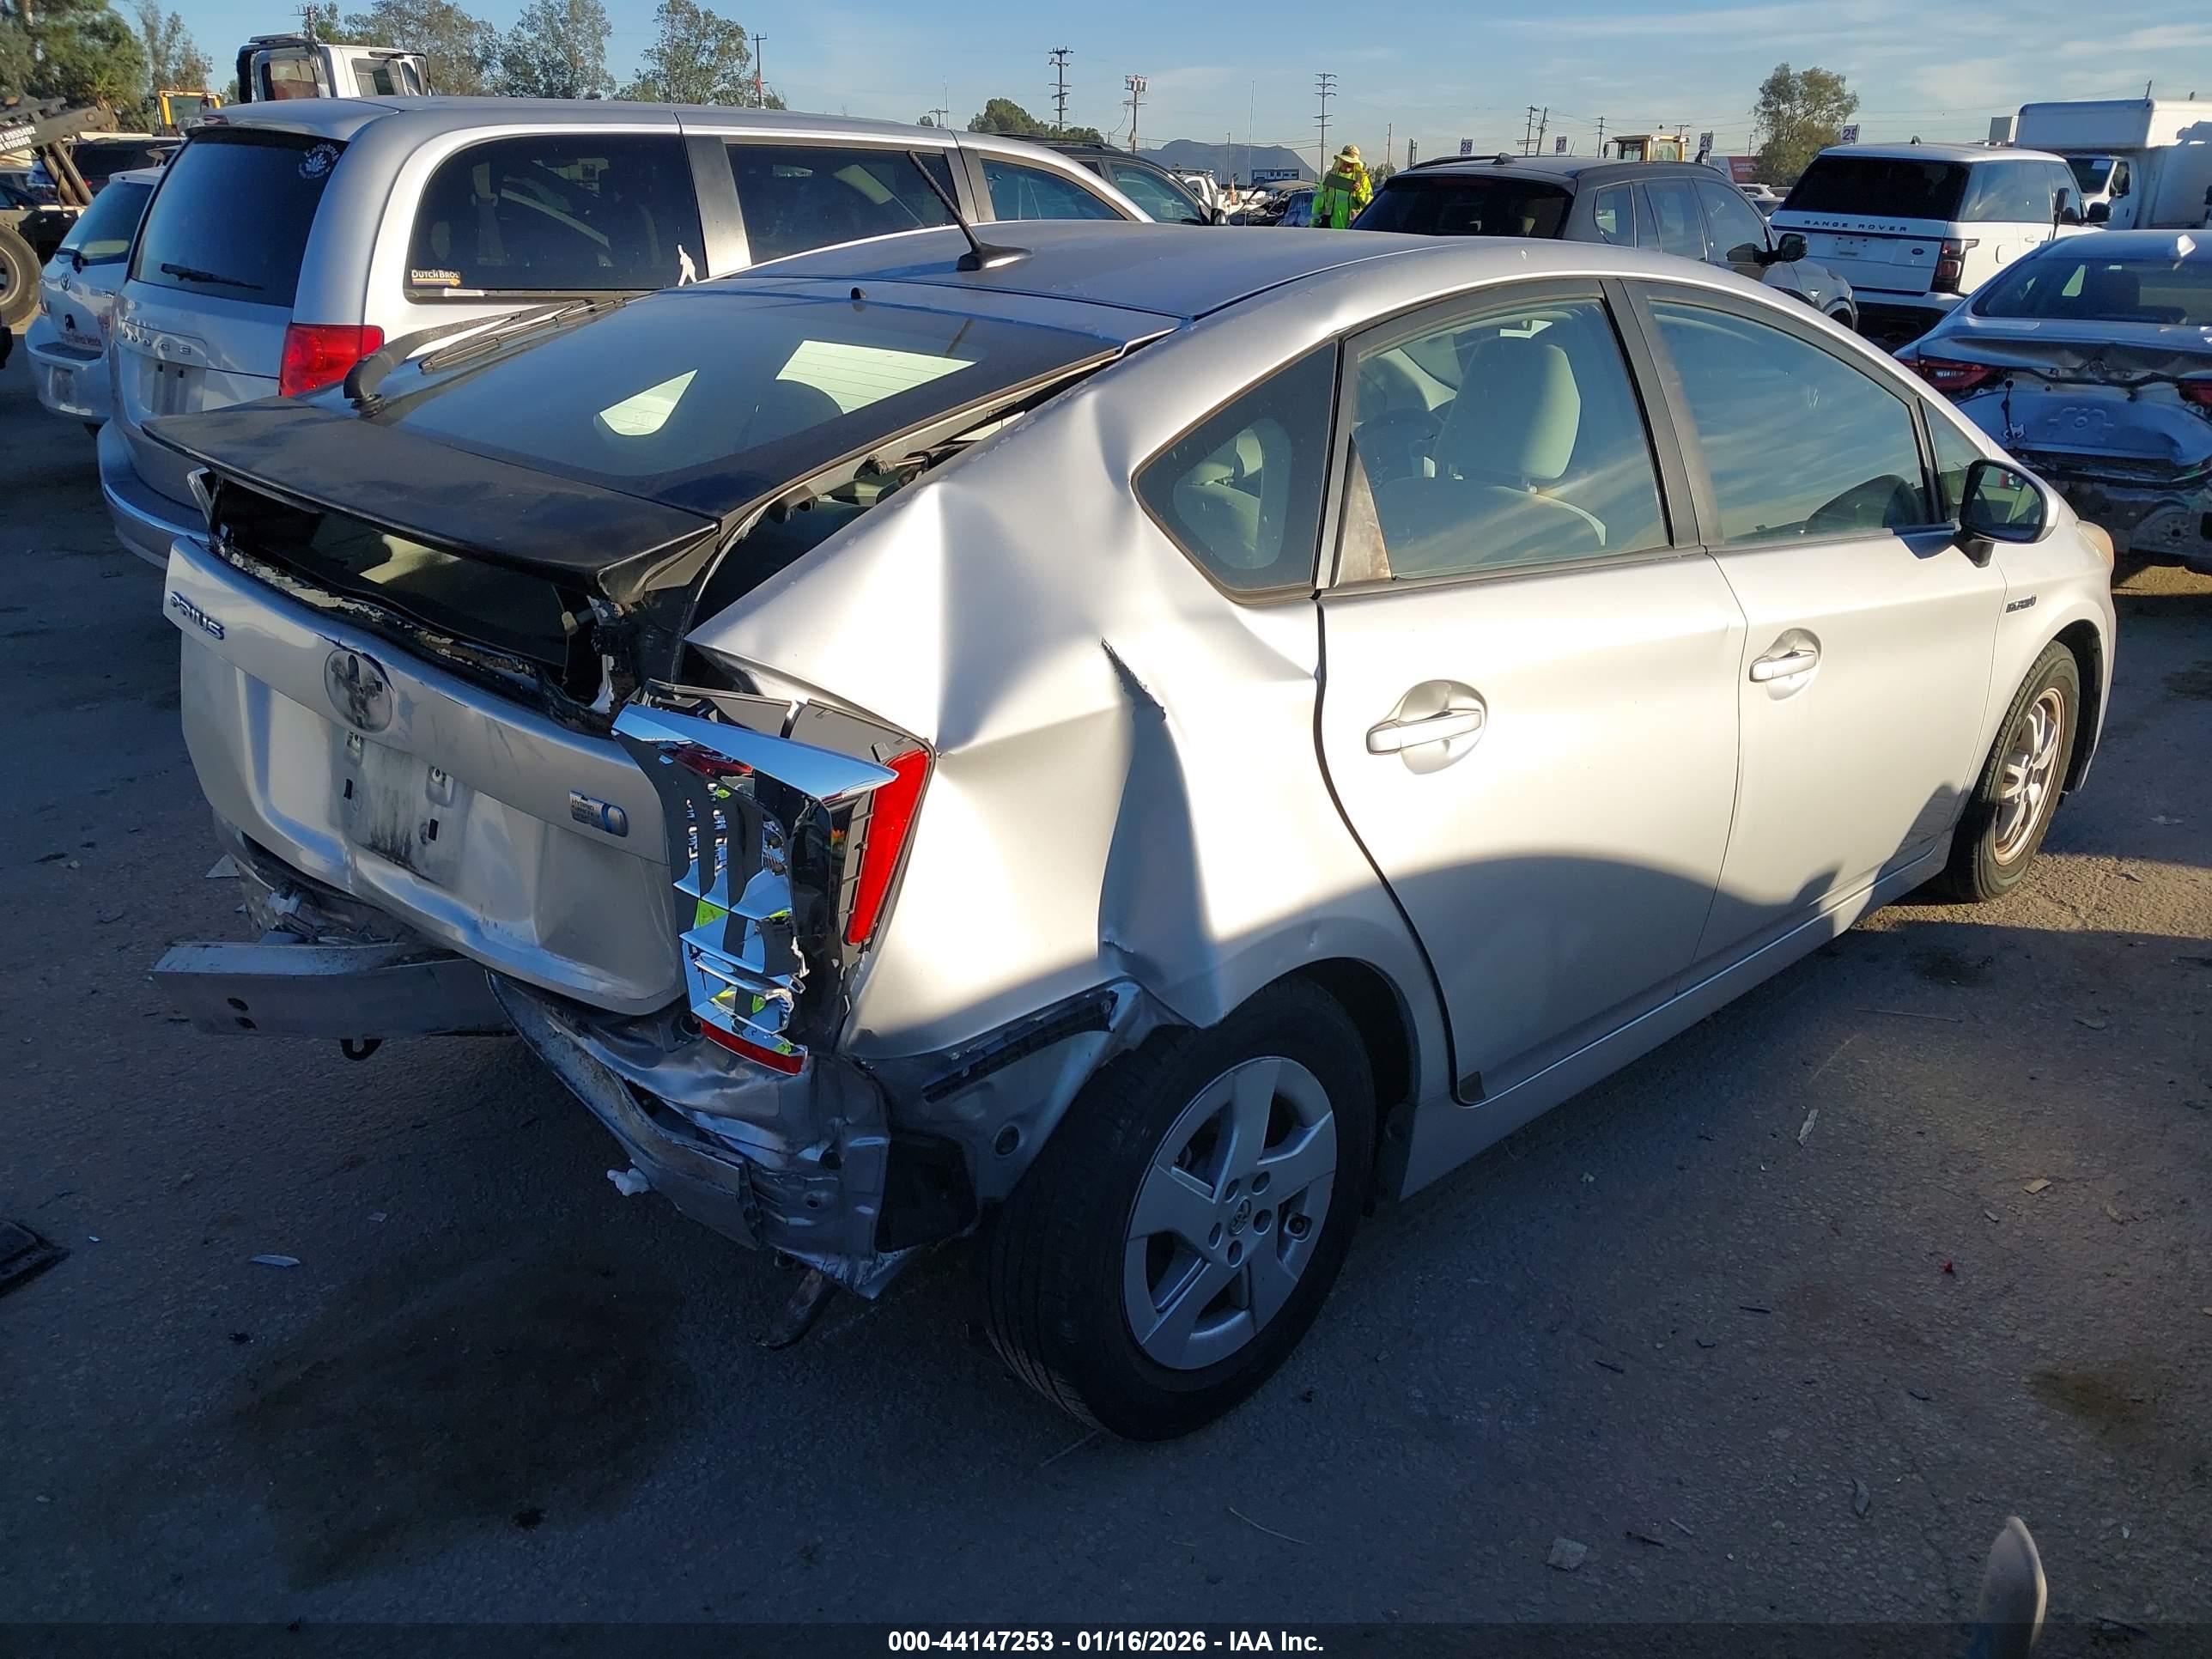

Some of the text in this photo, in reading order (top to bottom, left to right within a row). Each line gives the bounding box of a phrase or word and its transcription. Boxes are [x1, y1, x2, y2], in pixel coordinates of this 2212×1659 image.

[1461, 142, 1473, 152] 28
[1556, 139, 1566, 150] 27
[1804, 220, 1908, 232] RANGE ROVER
[170, 591, 225, 641] PRIUS
